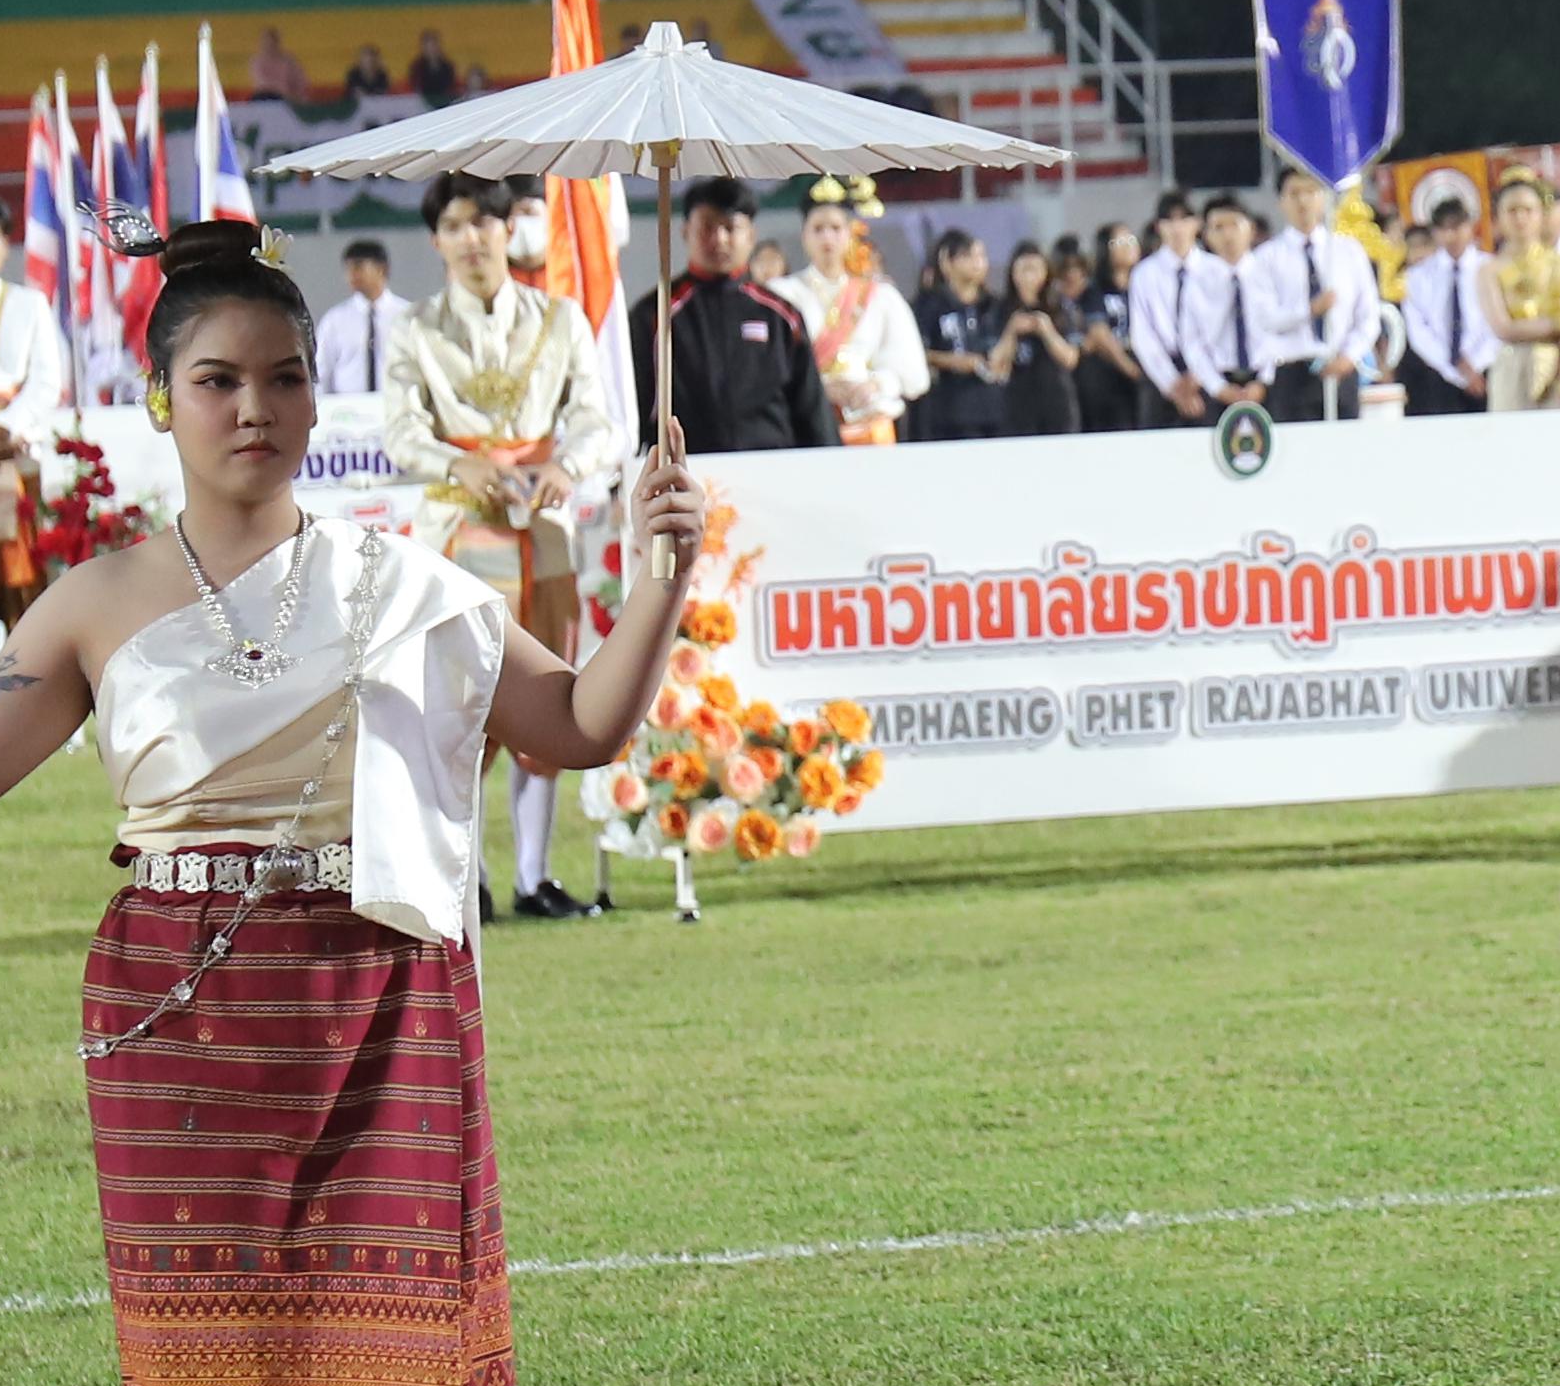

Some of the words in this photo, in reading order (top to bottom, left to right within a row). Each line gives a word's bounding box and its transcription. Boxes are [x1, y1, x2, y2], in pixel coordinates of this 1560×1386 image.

[866, 695, 1053, 744] MPHAENG
[1085, 690, 1177, 735] PHET
[1206, 675, 1401, 724] RAJABHAT
